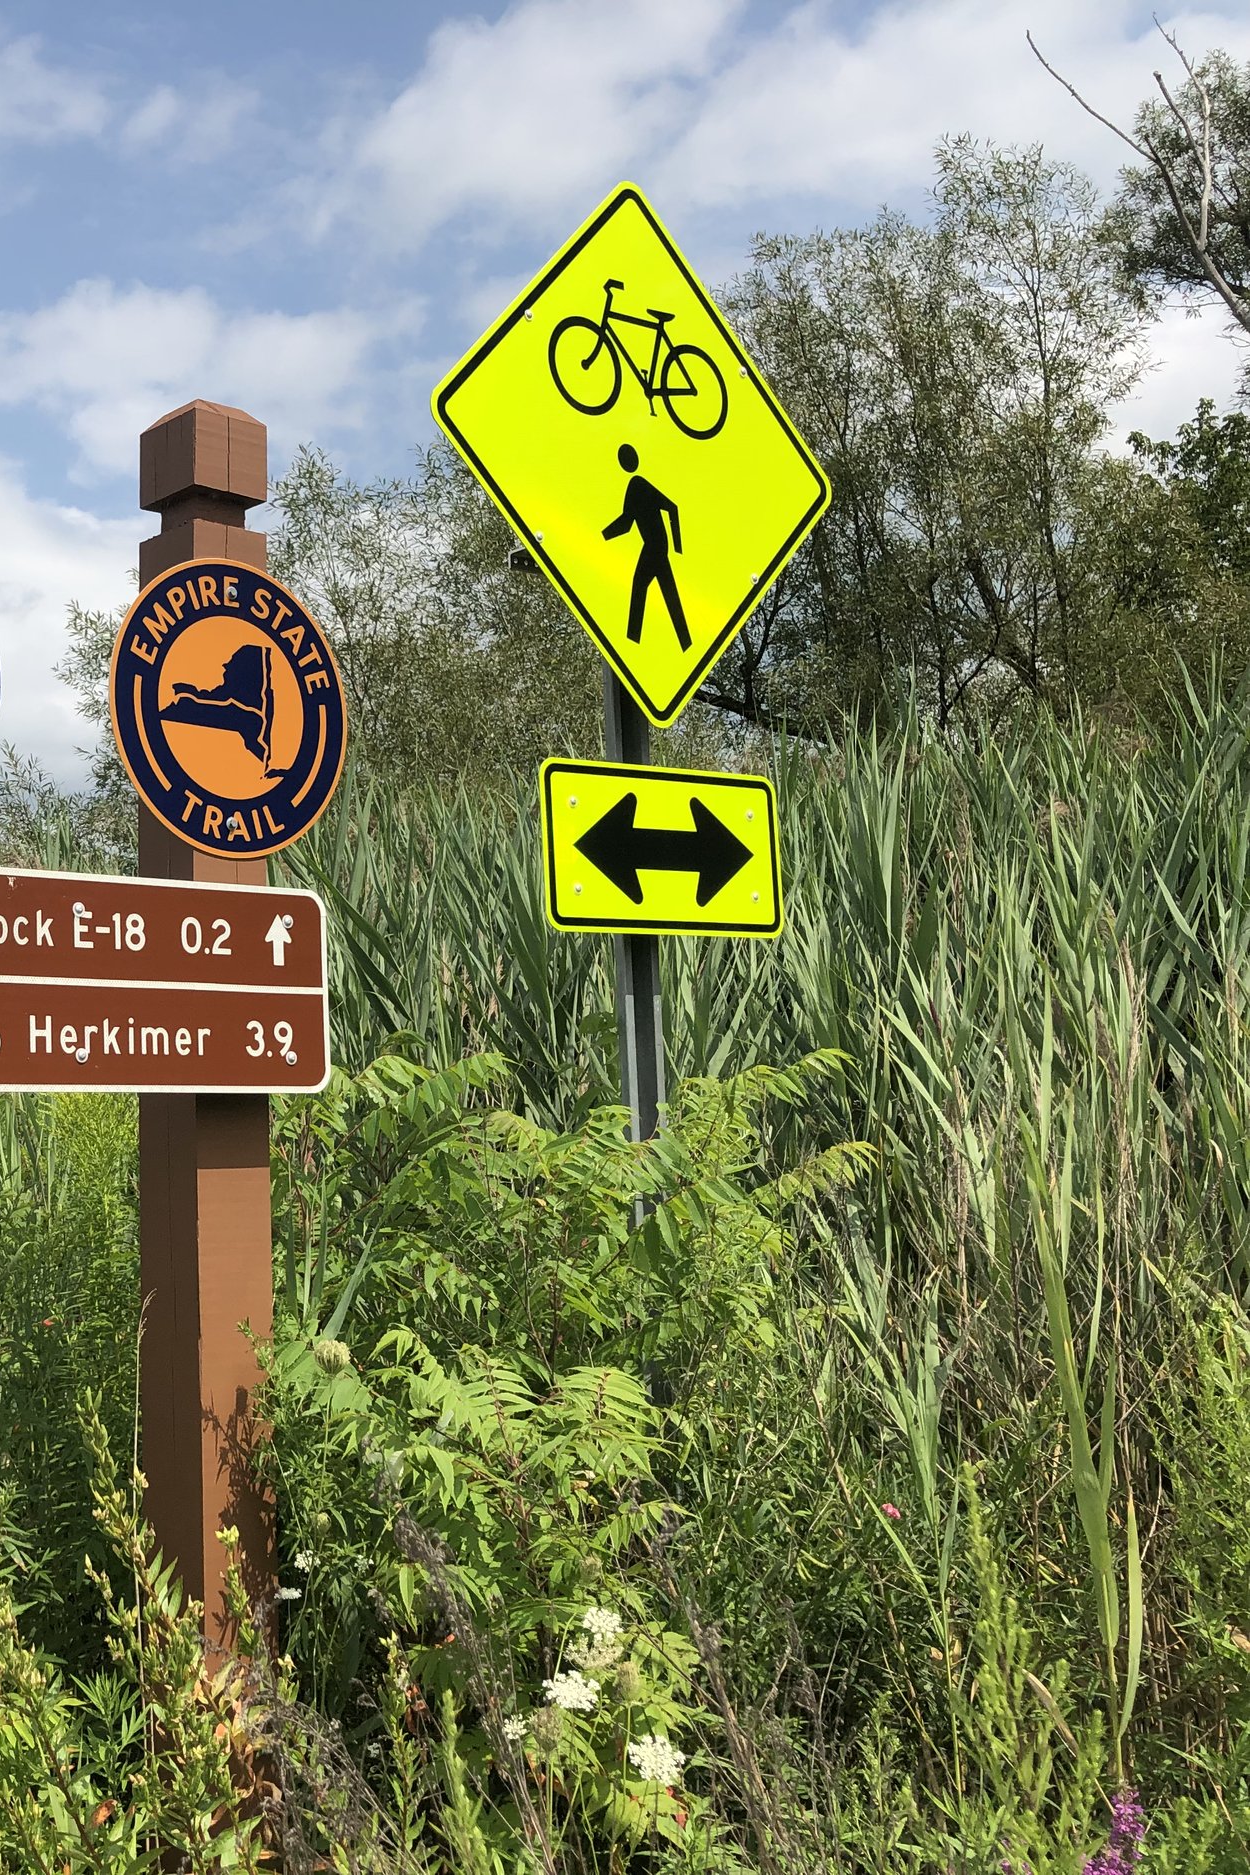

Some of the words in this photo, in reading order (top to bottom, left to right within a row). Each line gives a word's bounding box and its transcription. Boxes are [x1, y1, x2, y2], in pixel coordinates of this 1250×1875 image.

[130, 575, 240, 666] EMPIRE
[250, 588, 330, 695] STATE
[180, 790, 285, 842] TRAIL
[73, 912, 146, 951] E-18
[180, 917, 232, 956] 0.2
[28, 1015, 211, 1056] Herkimer
[245, 1020, 293, 1058] 3.9
